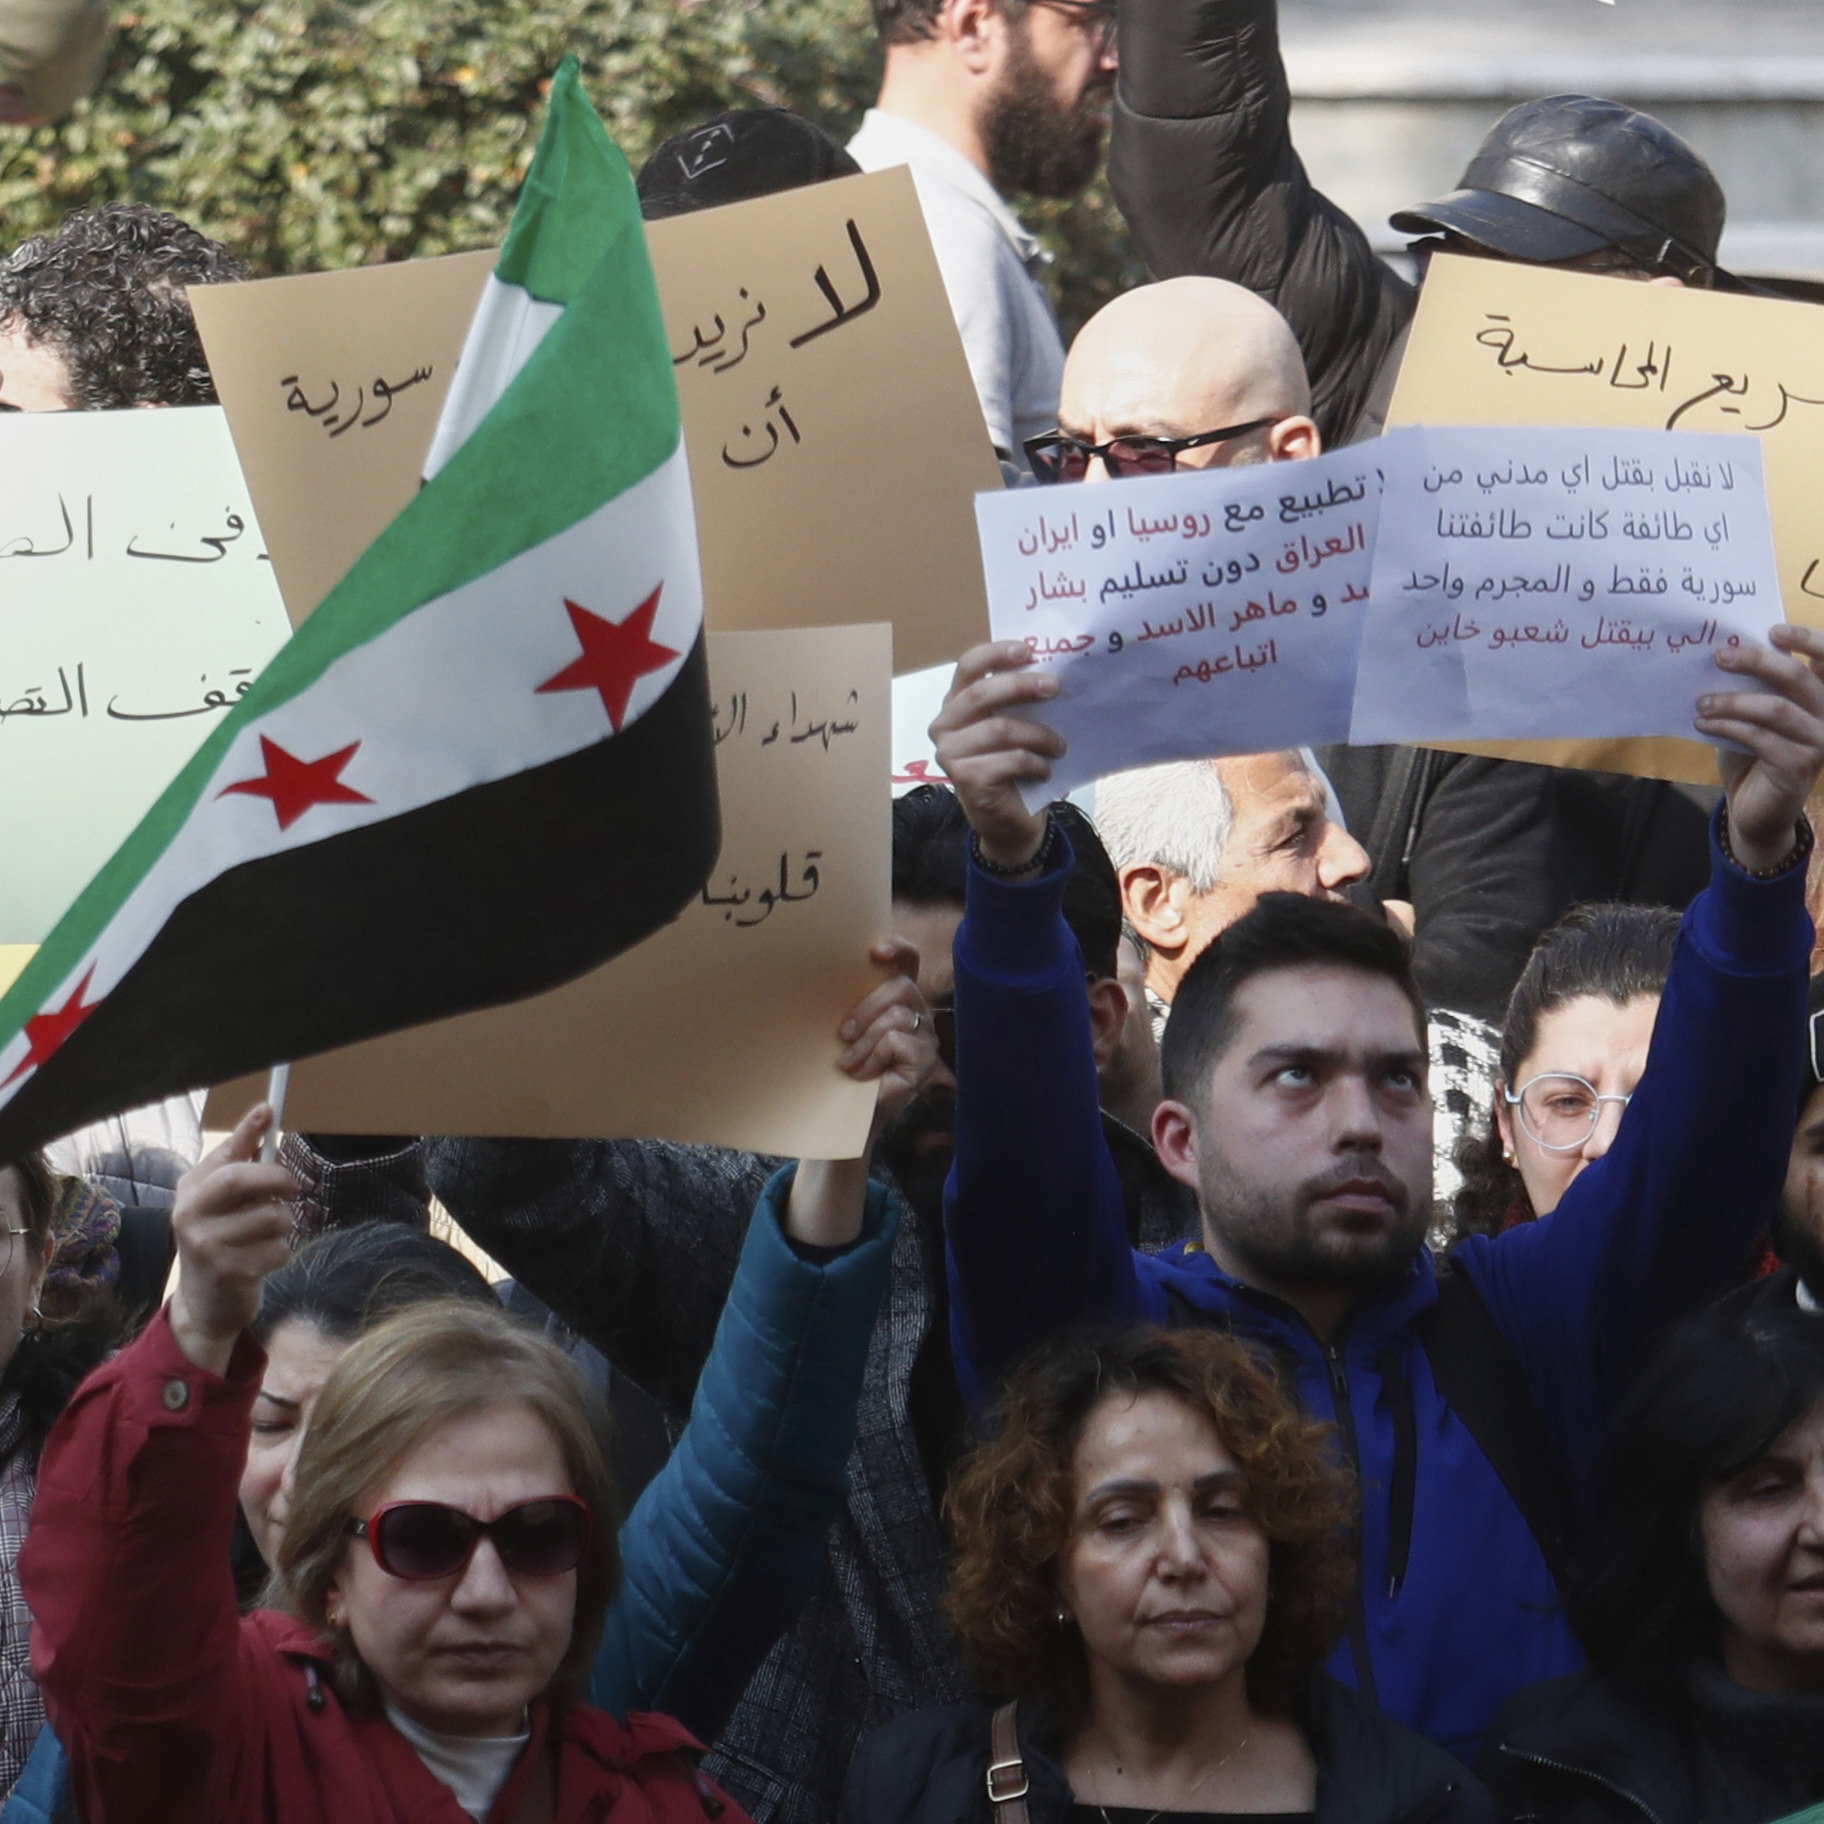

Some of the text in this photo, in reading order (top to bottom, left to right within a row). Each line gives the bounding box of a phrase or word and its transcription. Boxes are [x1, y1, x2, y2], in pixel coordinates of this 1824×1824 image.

[790, 218, 883, 349] لا
[1476, 314, 1824, 430] ريع المحاسبة
[281, 361, 433, 438] سورية
[722, 386, 800, 468] أن
[1424, 468, 1463, 492] من
[1477, 459, 1547, 495] مدني
[1562, 455, 1589, 495] اي
[1602, 455, 1654, 493] بقتل
[1665, 455, 1711, 493] نقبل
[1224, 503, 1264, 531] مع
[1279, 473, 1366, 523] تطبيع
[1018, 513, 1078, 556] ايران
[1091, 510, 1115, 548] او
[1127, 507, 1211, 542] روسيا
[1437, 508, 1729, 551] اي طائفة كانت طائفتنا
[1025, 523, 1365, 611] العراق دون تسليم بشار
[1402, 562, 1464, 600] واحد
[1475, 564, 1569, 601] المجرم
[1608, 565, 1667, 595] فقط
[1682, 567, 1756, 604] سورية
[1312, 592, 1327, 618] و
[1579, 579, 1594, 602] و
[1137, 602, 1216, 643] الاسد
[1228, 591, 1297, 632] ماهر
[1107, 629, 1123, 653] و
[1417, 614, 1480, 650] خاين
[1489, 618, 1568, 650] شعبو
[1581, 618, 1654, 651] بيقتل
[1667, 621, 1716, 653] الي
[1172, 639, 1278, 686] اتباعهم
[107, 668, 253, 722] قف
[761, 689, 858, 752] شهداء
